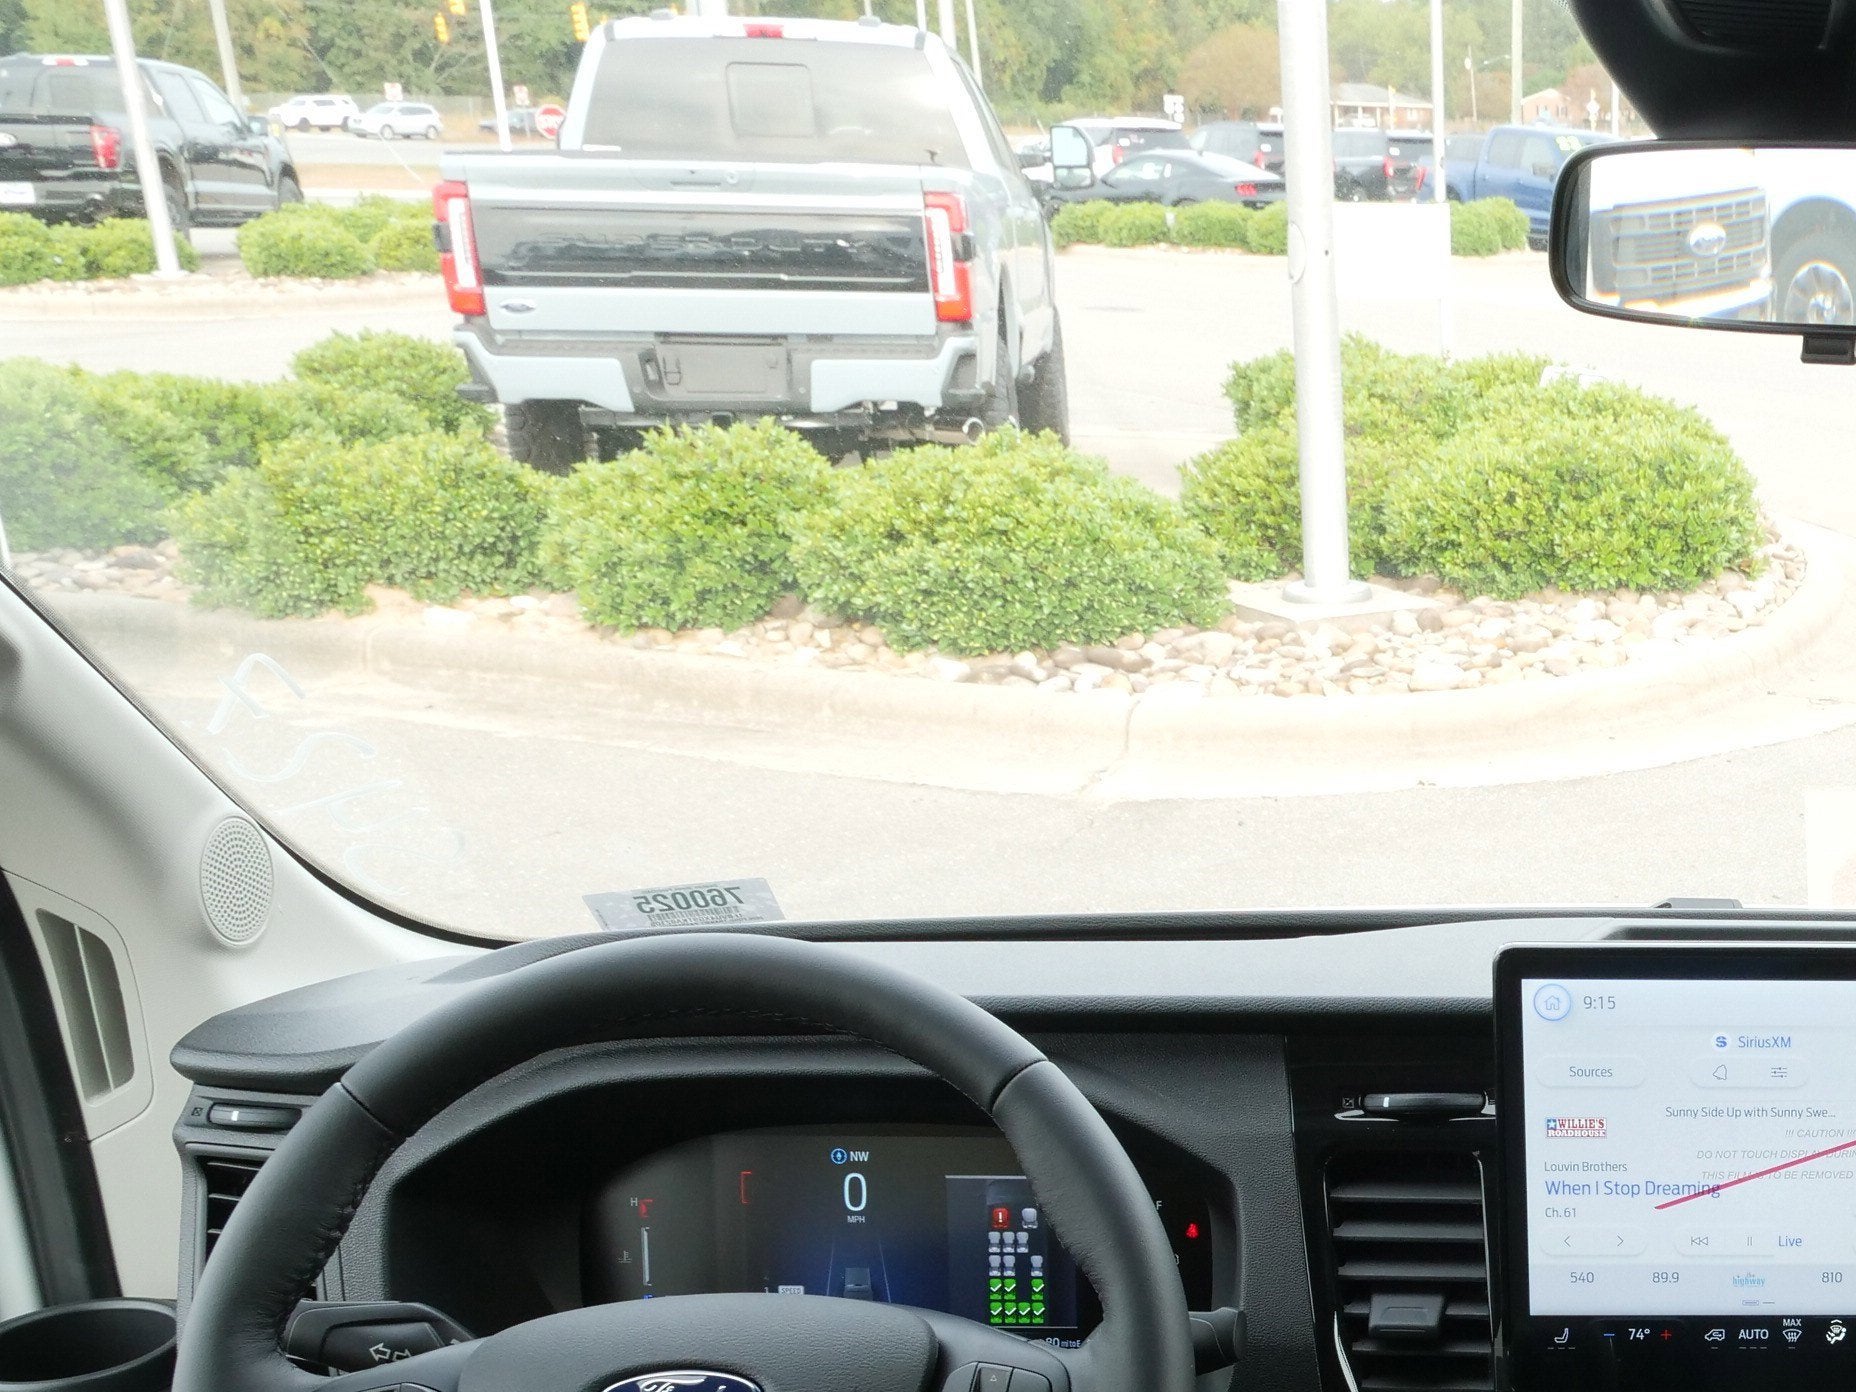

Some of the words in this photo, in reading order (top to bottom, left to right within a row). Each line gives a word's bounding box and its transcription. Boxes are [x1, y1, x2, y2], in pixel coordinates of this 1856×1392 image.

[1583, 995, 1616, 1010] 9:15
[1738, 1035, 1792, 1049] SiriusXM
[1569, 1065, 1613, 1078] Sources
[1665, 1106, 1698, 1119] Sunny
[1701, 1106, 1725, 1118] Side
[1727, 1106, 1742, 1120] Up
[1744, 1106, 1769, 1118] with
[1770, 1106, 1804, 1119] Sunny
[1557, 1118, 1605, 1129] WILLIE'S
[1548, 1129, 1607, 1138] ROADHOUSE
[1796, 1128, 1844, 1138] CAUTION
[849, 1150, 870, 1162] NW
[1696, 1149, 1713, 1160] DO
[1715, 1149, 1737, 1160] NOT
[1741, 1149, 1779, 1160] TOUCH
[1544, 1161, 1580, 1172] Louvin
[1582, 1161, 1627, 1172] Brothers
[1701, 1170, 1725, 1180] THIS
[1784, 1170, 1798, 1180] BE
[843, 1172, 867, 1212] 0
[1545, 1180, 1591, 1196] When
[1604, 1180, 1641, 1199] Stop
[1645, 1180, 1721, 1199] Dreaming
[629, 1197, 639, 1207] H
[1545, 1207, 1562, 1218] Ch.
[1564, 1207, 1577, 1218] 61
[846, 1214, 867, 1224] MPH
[1778, 1235, 1803, 1247] Live
[1570, 1271, 1595, 1284] 540
[1652, 1271, 1680, 1284] 89.9
[1732, 1275, 1766, 1288] highway
[1821, 1271, 1843, 1284] 810
[1783, 1318, 1802, 1327] MAX
[1628, 1328, 1651, 1341] 74°
[1738, 1328, 1770, 1341] AUTO
